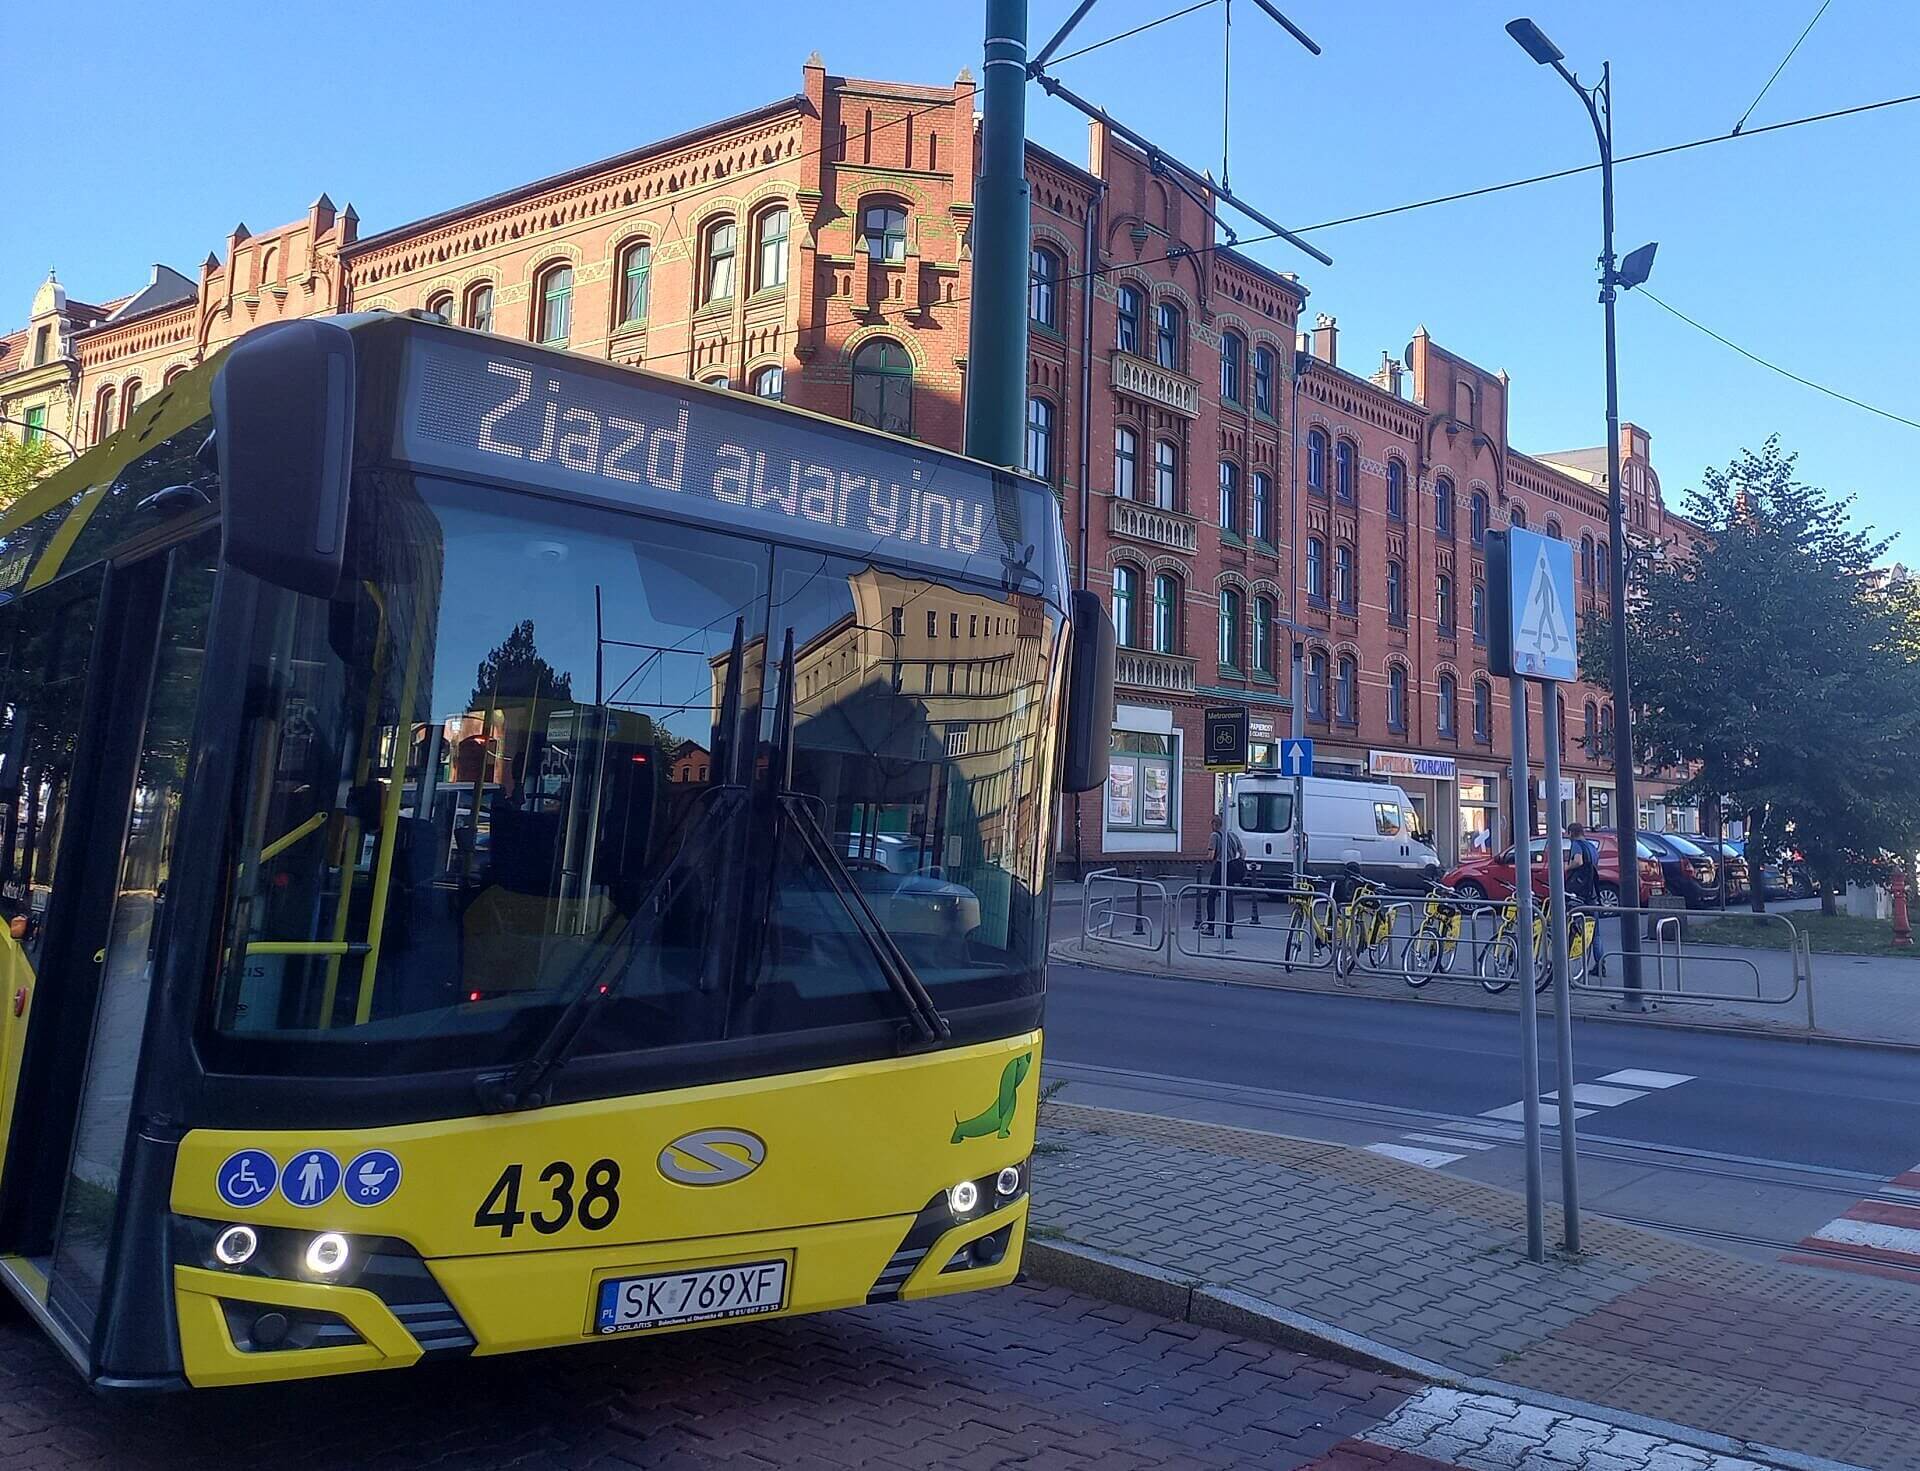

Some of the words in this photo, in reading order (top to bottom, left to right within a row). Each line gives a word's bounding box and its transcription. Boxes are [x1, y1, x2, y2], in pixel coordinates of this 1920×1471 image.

[477, 361, 690, 493] Zjazd
[714, 441, 984, 555] awaryjny
[474, 1158, 621, 1238] 438
[602, 1309, 614, 1320] PL
[623, 1280, 667, 1319] SK
[678, 1268, 776, 1313] 769XF
[616, 1321, 653, 1332] SOLARIS
